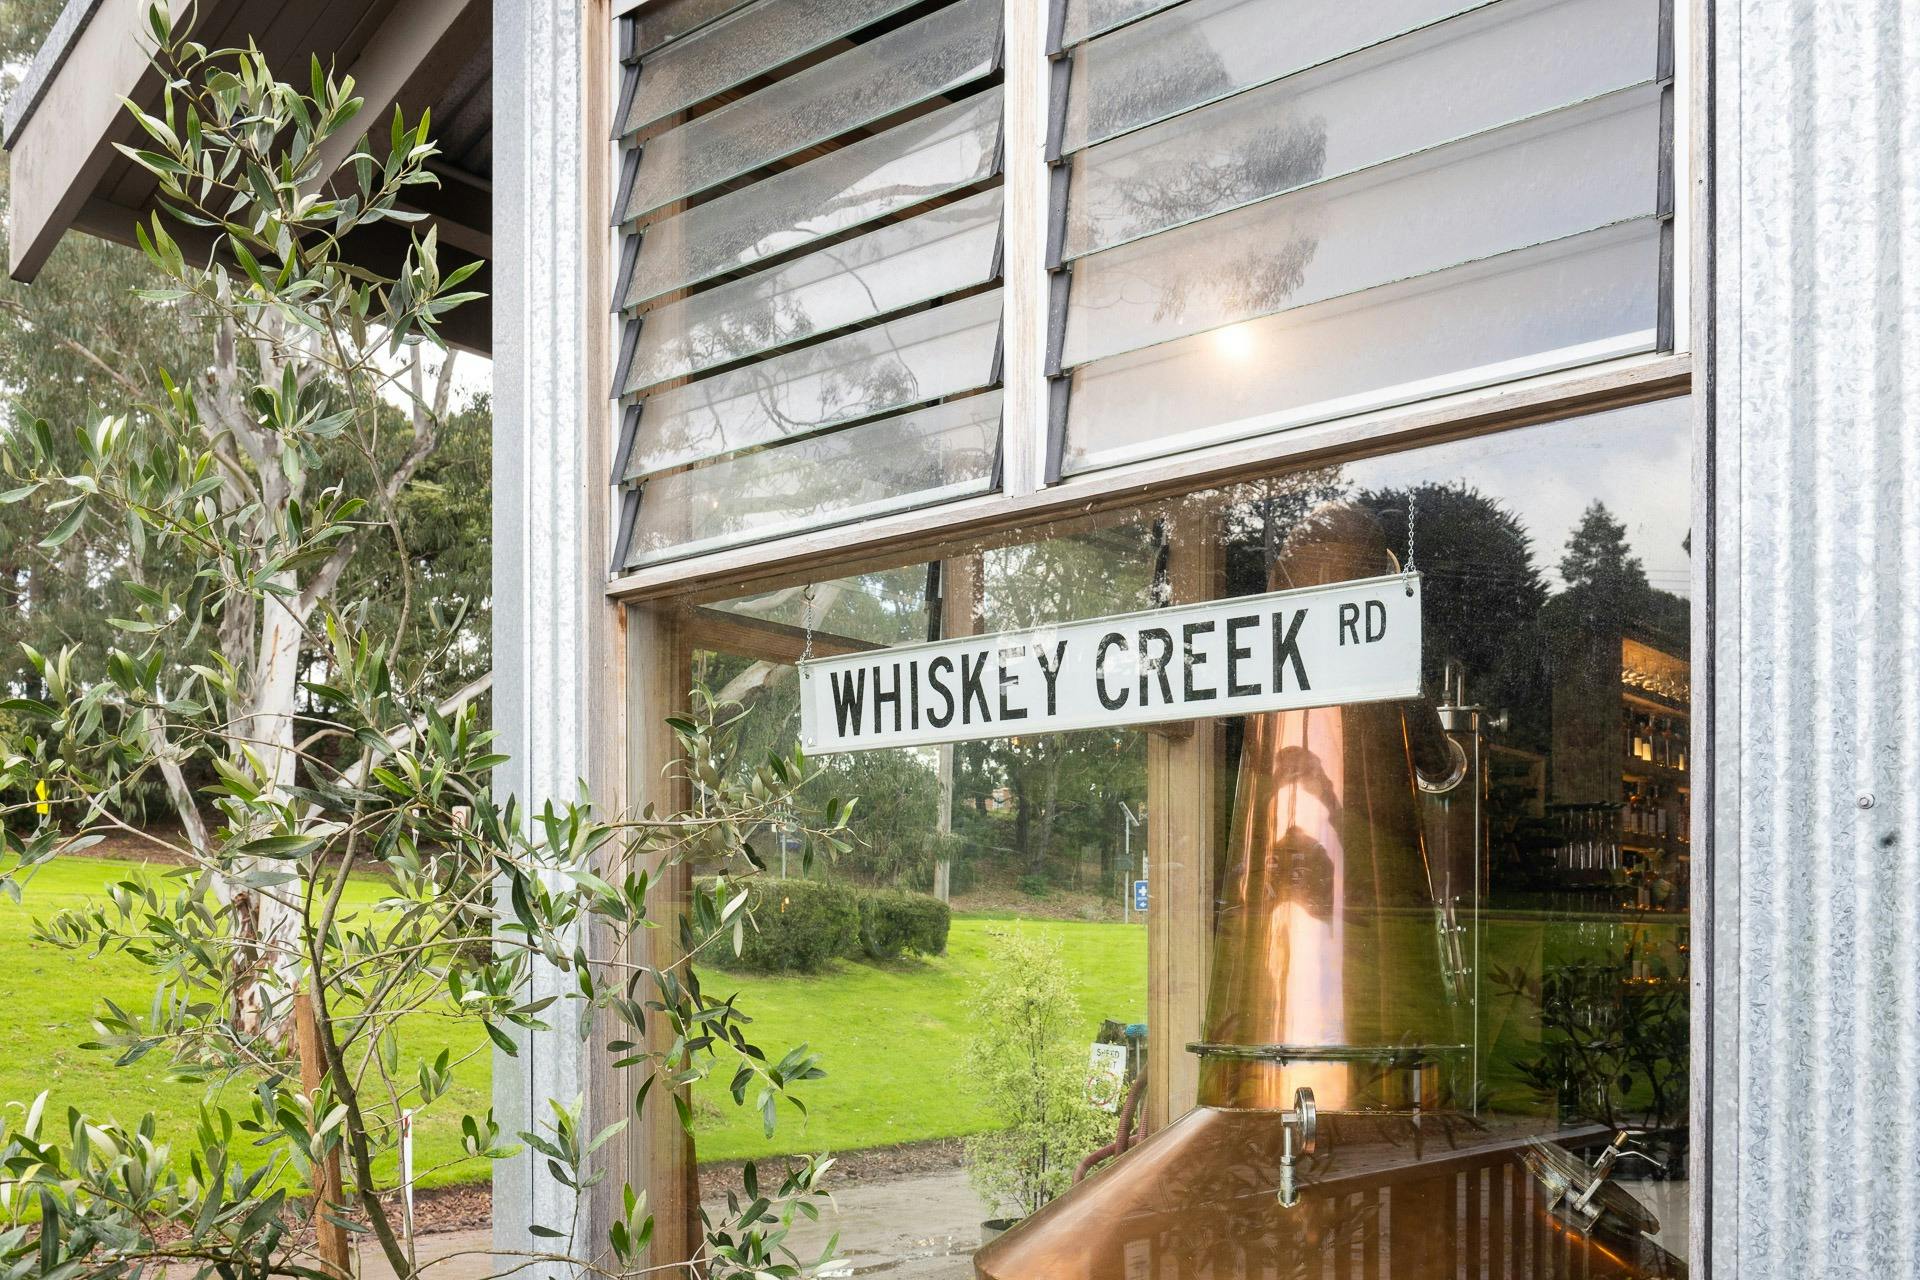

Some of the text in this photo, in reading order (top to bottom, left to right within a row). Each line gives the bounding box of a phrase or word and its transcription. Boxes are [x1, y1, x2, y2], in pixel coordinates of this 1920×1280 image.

[831, 599, 1387, 738] WHISKEY CREEK RD
